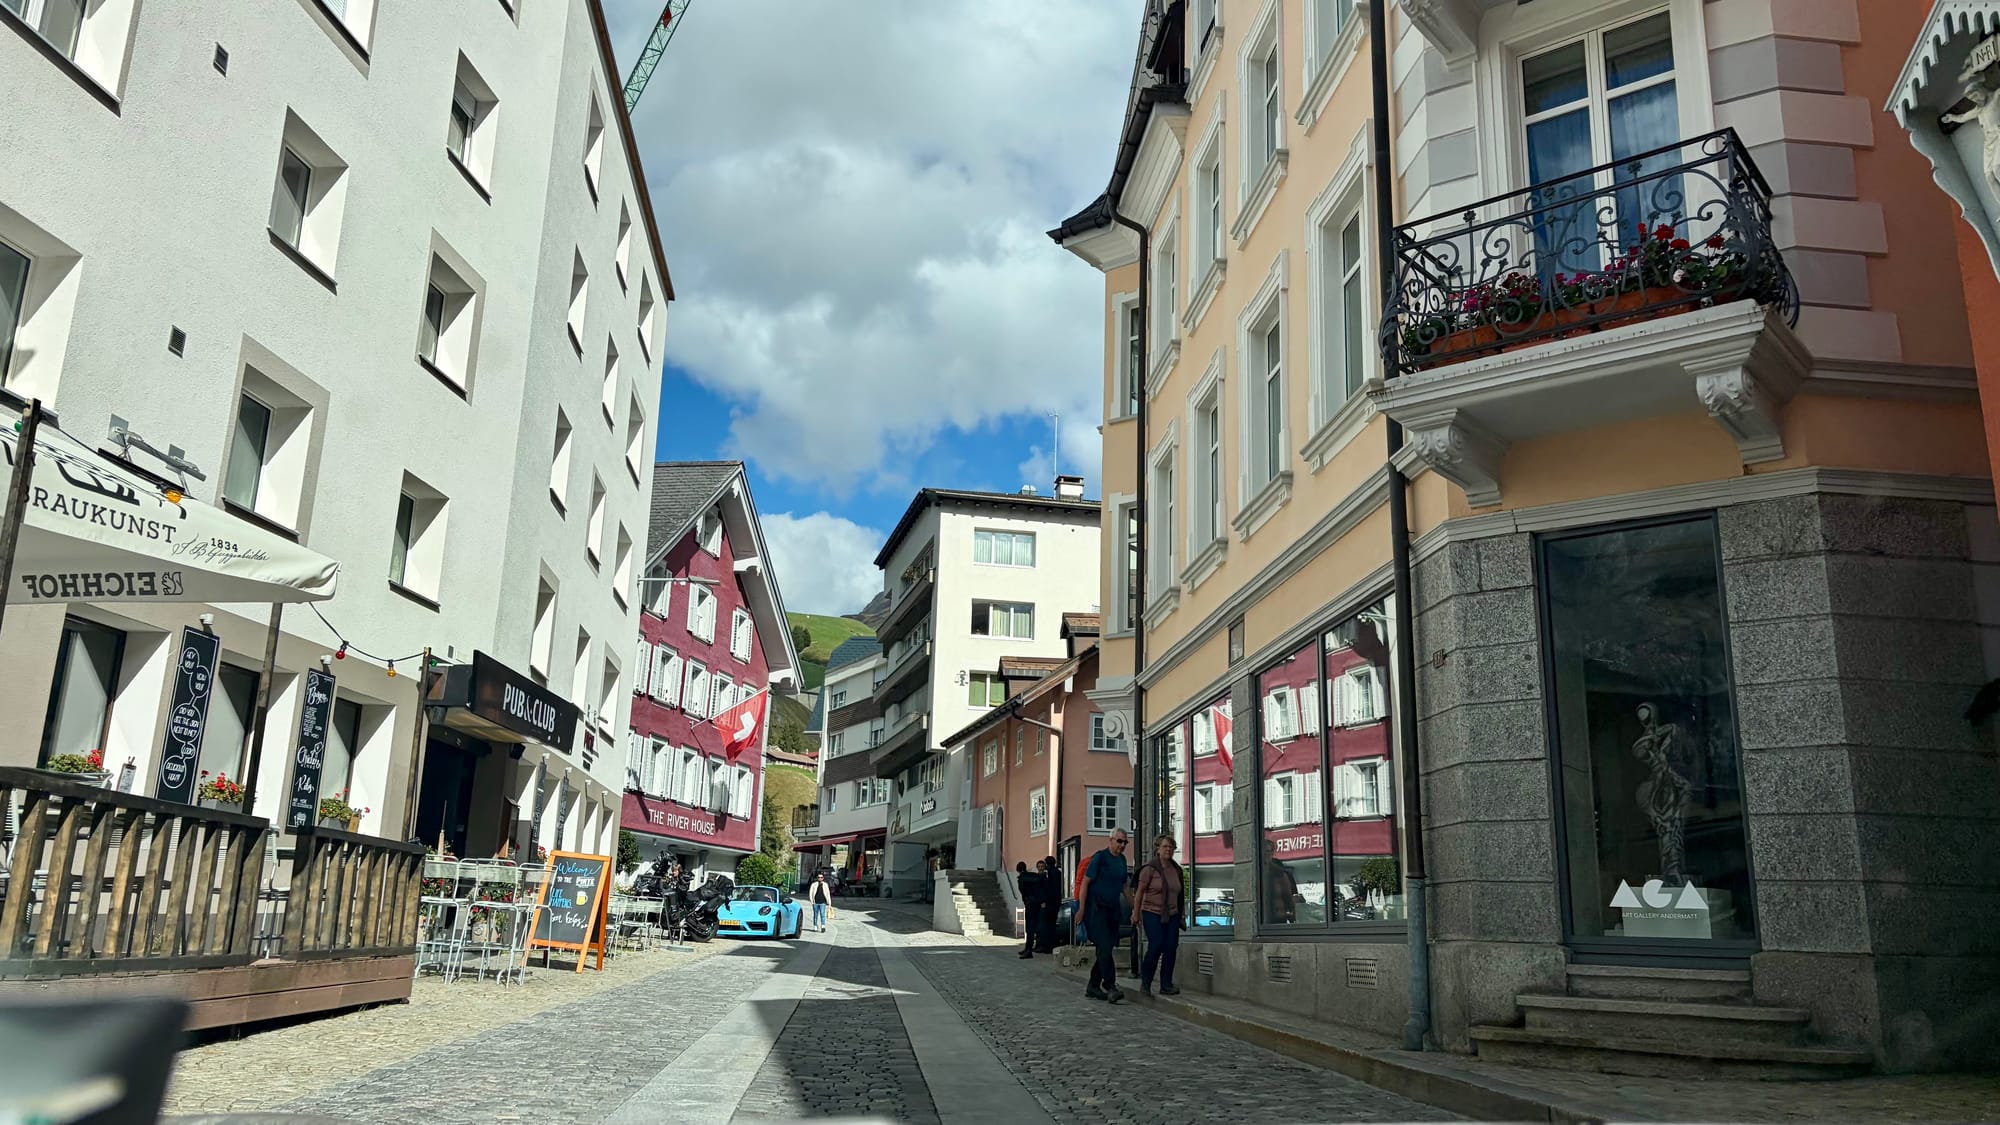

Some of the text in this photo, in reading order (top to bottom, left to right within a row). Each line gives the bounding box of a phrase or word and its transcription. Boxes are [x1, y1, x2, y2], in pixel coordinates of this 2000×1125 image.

[211, 538, 239, 552] 1834
[648, 808, 715, 835] THE RIVER HOUSE
[1609, 879, 1709, 909] AGA
[1622, 912, 1698, 920] ART GALLERY ANDERMATT
